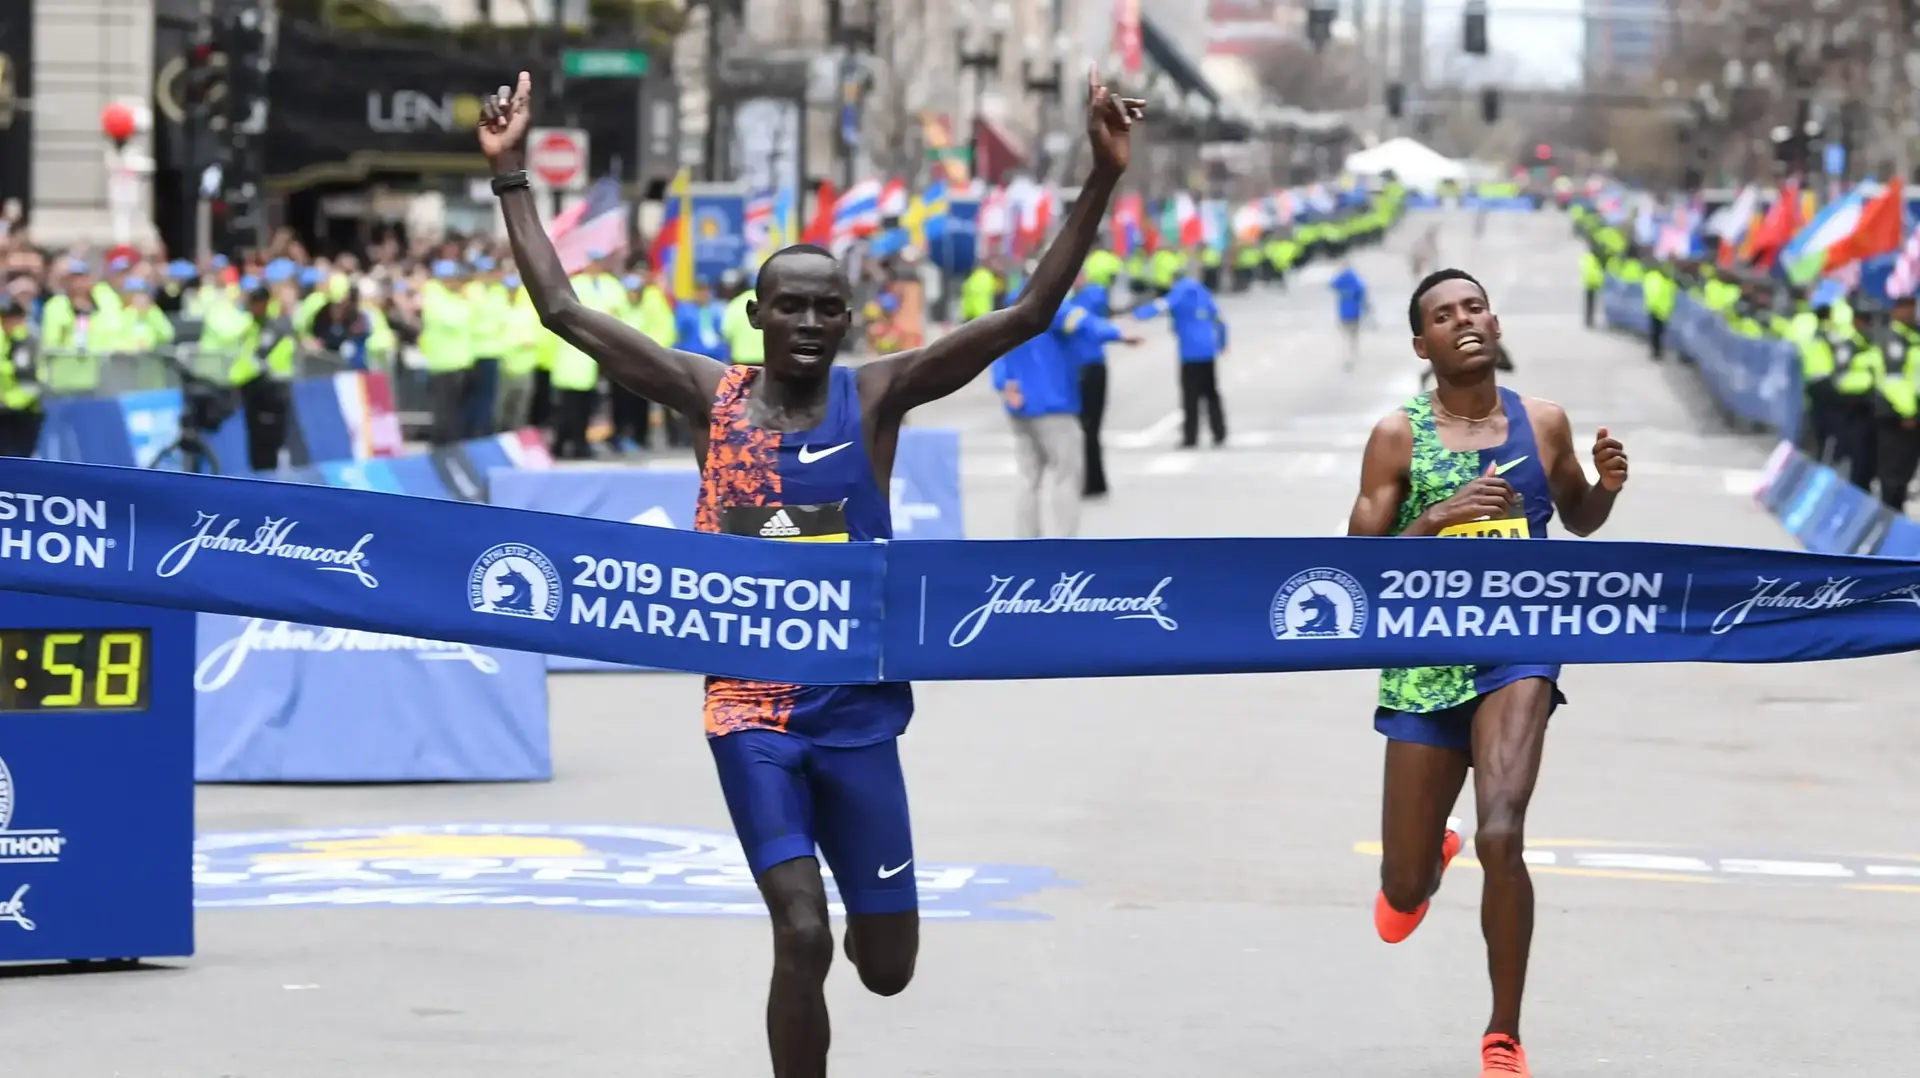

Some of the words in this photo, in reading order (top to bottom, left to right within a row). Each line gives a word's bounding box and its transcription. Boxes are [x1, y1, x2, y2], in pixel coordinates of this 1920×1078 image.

[247, 516, 379, 589] Hancock
[572, 554, 663, 595] 2019
[670, 566, 851, 612] BOSTON
[1041, 570, 1179, 631] Hancock
[1379, 570, 1473, 599] 2019
[1480, 570, 1663, 599] BOSTON
[570, 593, 849, 651] MARATHON
[1376, 604, 1656, 638] MARATHON
[0, 633, 142, 706] :58
